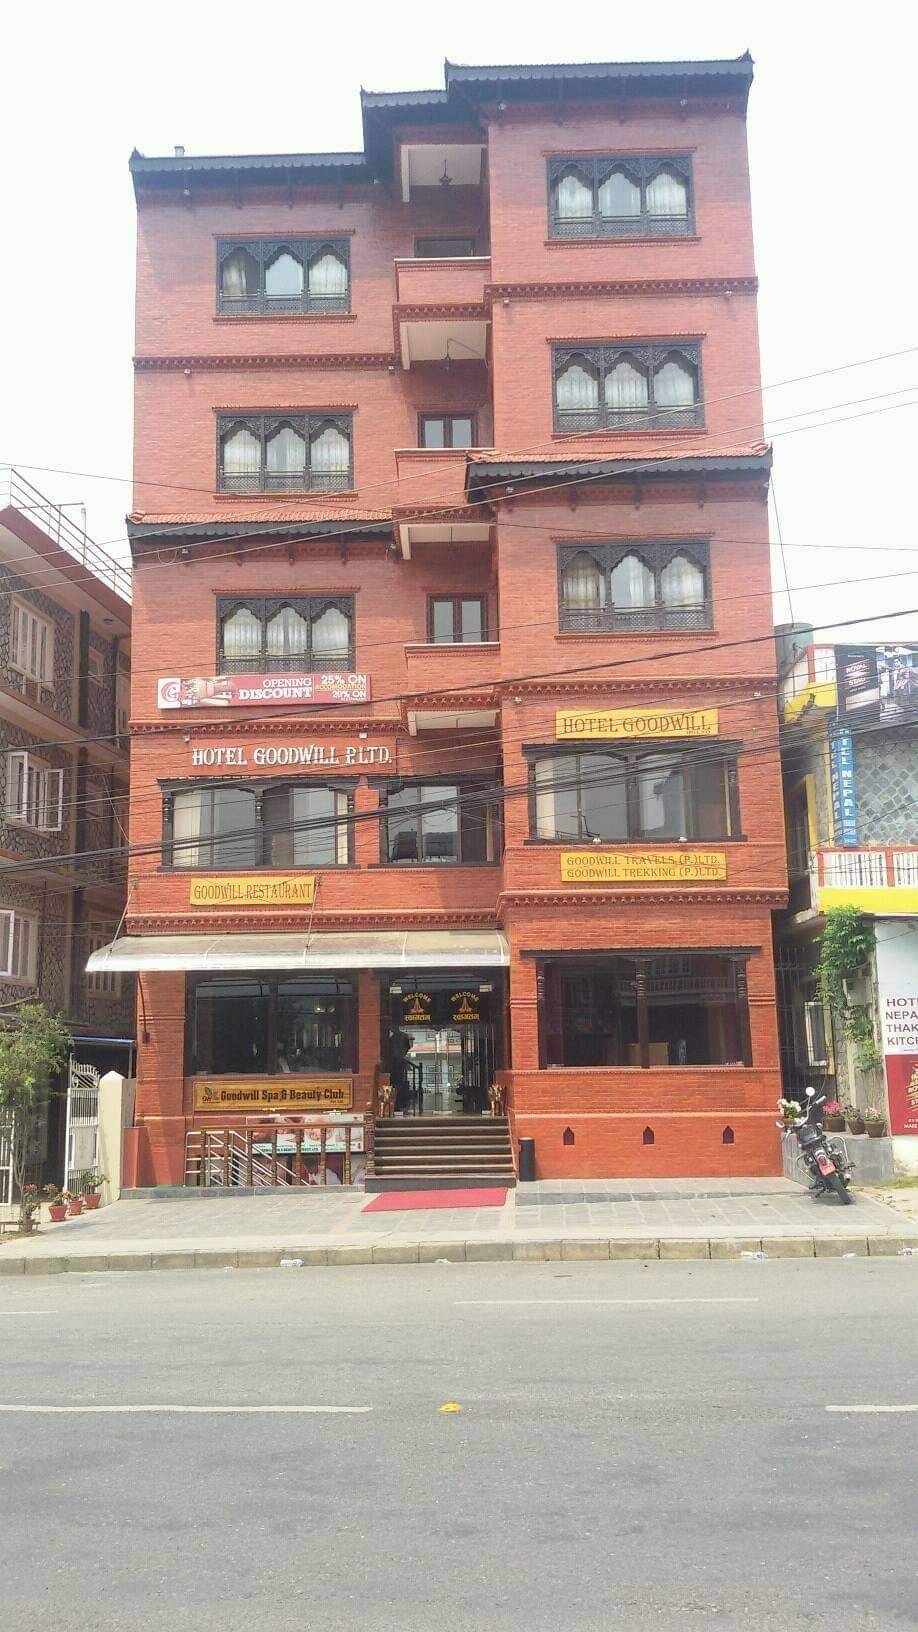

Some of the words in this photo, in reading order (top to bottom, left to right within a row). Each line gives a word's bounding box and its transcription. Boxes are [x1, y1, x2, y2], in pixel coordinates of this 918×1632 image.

[263, 678, 312, 688] OPENING
[321, 674, 345, 684] 25%
[348, 674, 366, 684] ON
[238, 687, 312, 700] DISCOUNT
[352, 690, 366, 698] ON
[563, 718, 619, 734] HOTEL
[623, 713, 711, 734] GOODWILL
[192, 747, 248, 766] HOTEL
[253, 743, 340, 765] GOODWILL
[841, 770, 854, 817] NEPAL
[567, 855, 620, 865] GOODWILL
[625, 855, 675, 865] TRAVELS
[567, 868, 620, 878] GOODWILL
[624, 867, 676, 878] TREKKING
[194, 882, 243, 899] GOODWILL
[247, 882, 312, 899] RESTAURANT
[402, 992, 432, 1003] WELCOME
[450, 991, 480, 1002] WELCOME
[886, 998, 918, 1007] HOT
[886, 1011, 918, 1020] NEPA
[886, 1023, 918, 1032] THAK
[220, 1090, 259, 1101] Goodwill
[262, 1089, 279, 1102] Spa
[290, 1088, 321, 1101] Beauty
[324, 1088, 344, 1099] Club
